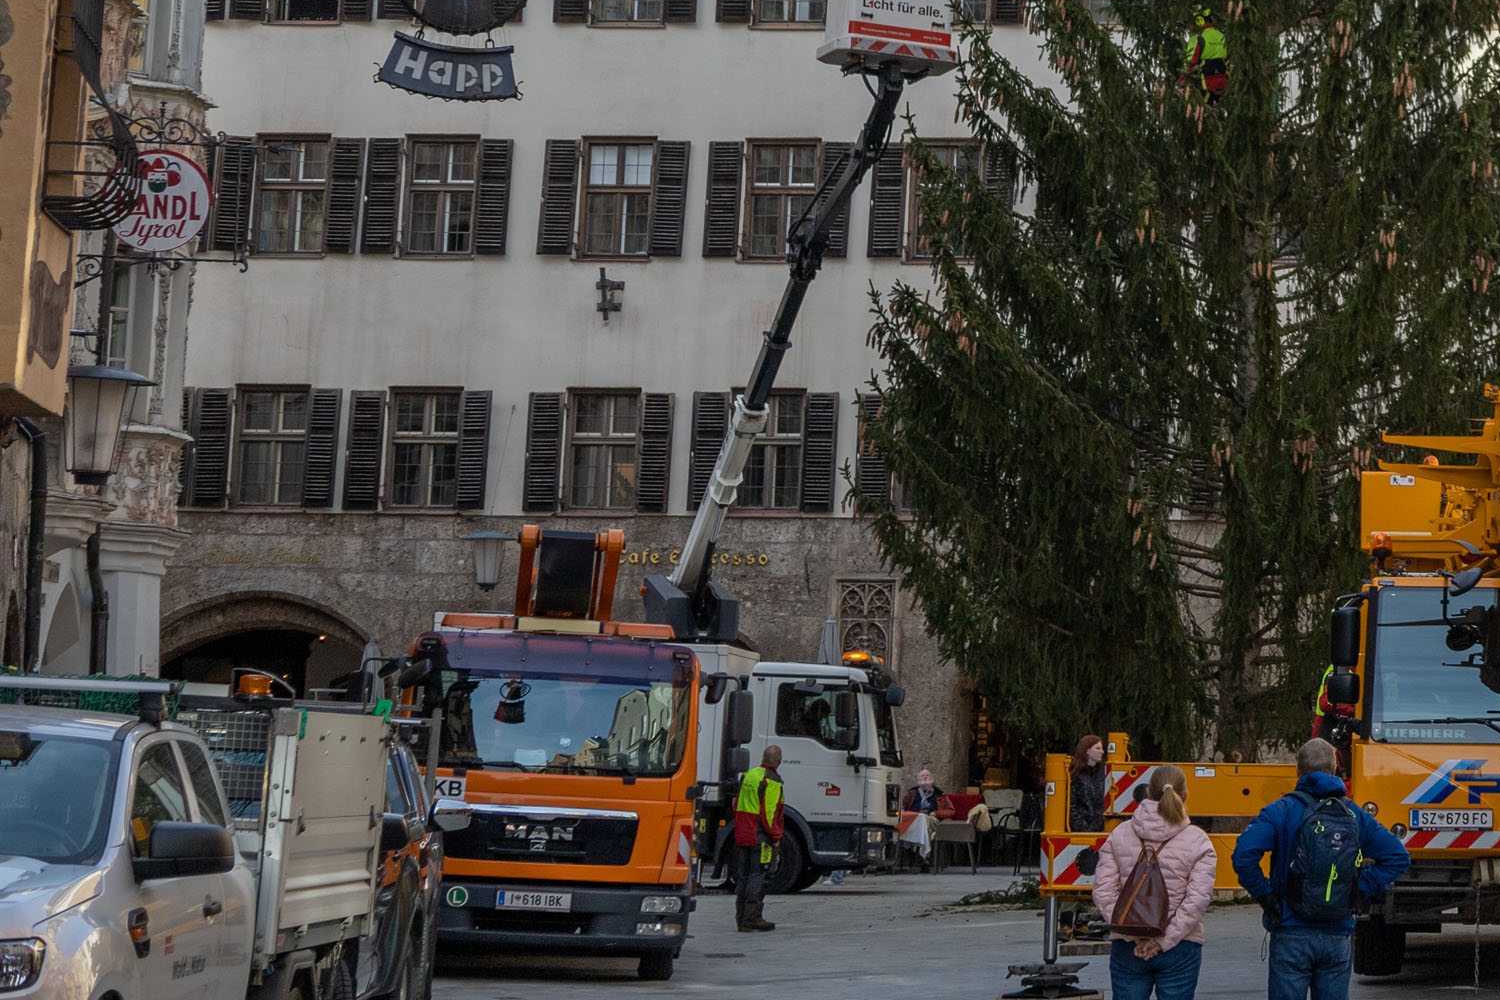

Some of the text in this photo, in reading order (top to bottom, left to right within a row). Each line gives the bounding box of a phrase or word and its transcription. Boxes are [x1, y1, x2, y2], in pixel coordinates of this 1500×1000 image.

[897, 1, 915, 15] für
[918, 5, 944, 19] alle.
[394, 45, 504, 92] Happ
[119, 216, 188, 247] Tyrol
[669, 550, 769, 566] Eresso
[1384, 728, 1466, 740] LIEBHERR
[1421, 812, 1488, 825] SZ 679 FC
[505, 823, 574, 841] MAN
[452, 890, 462, 904] L
[522, 894, 542, 906] 618
[544, 895, 562, 907] IBK
